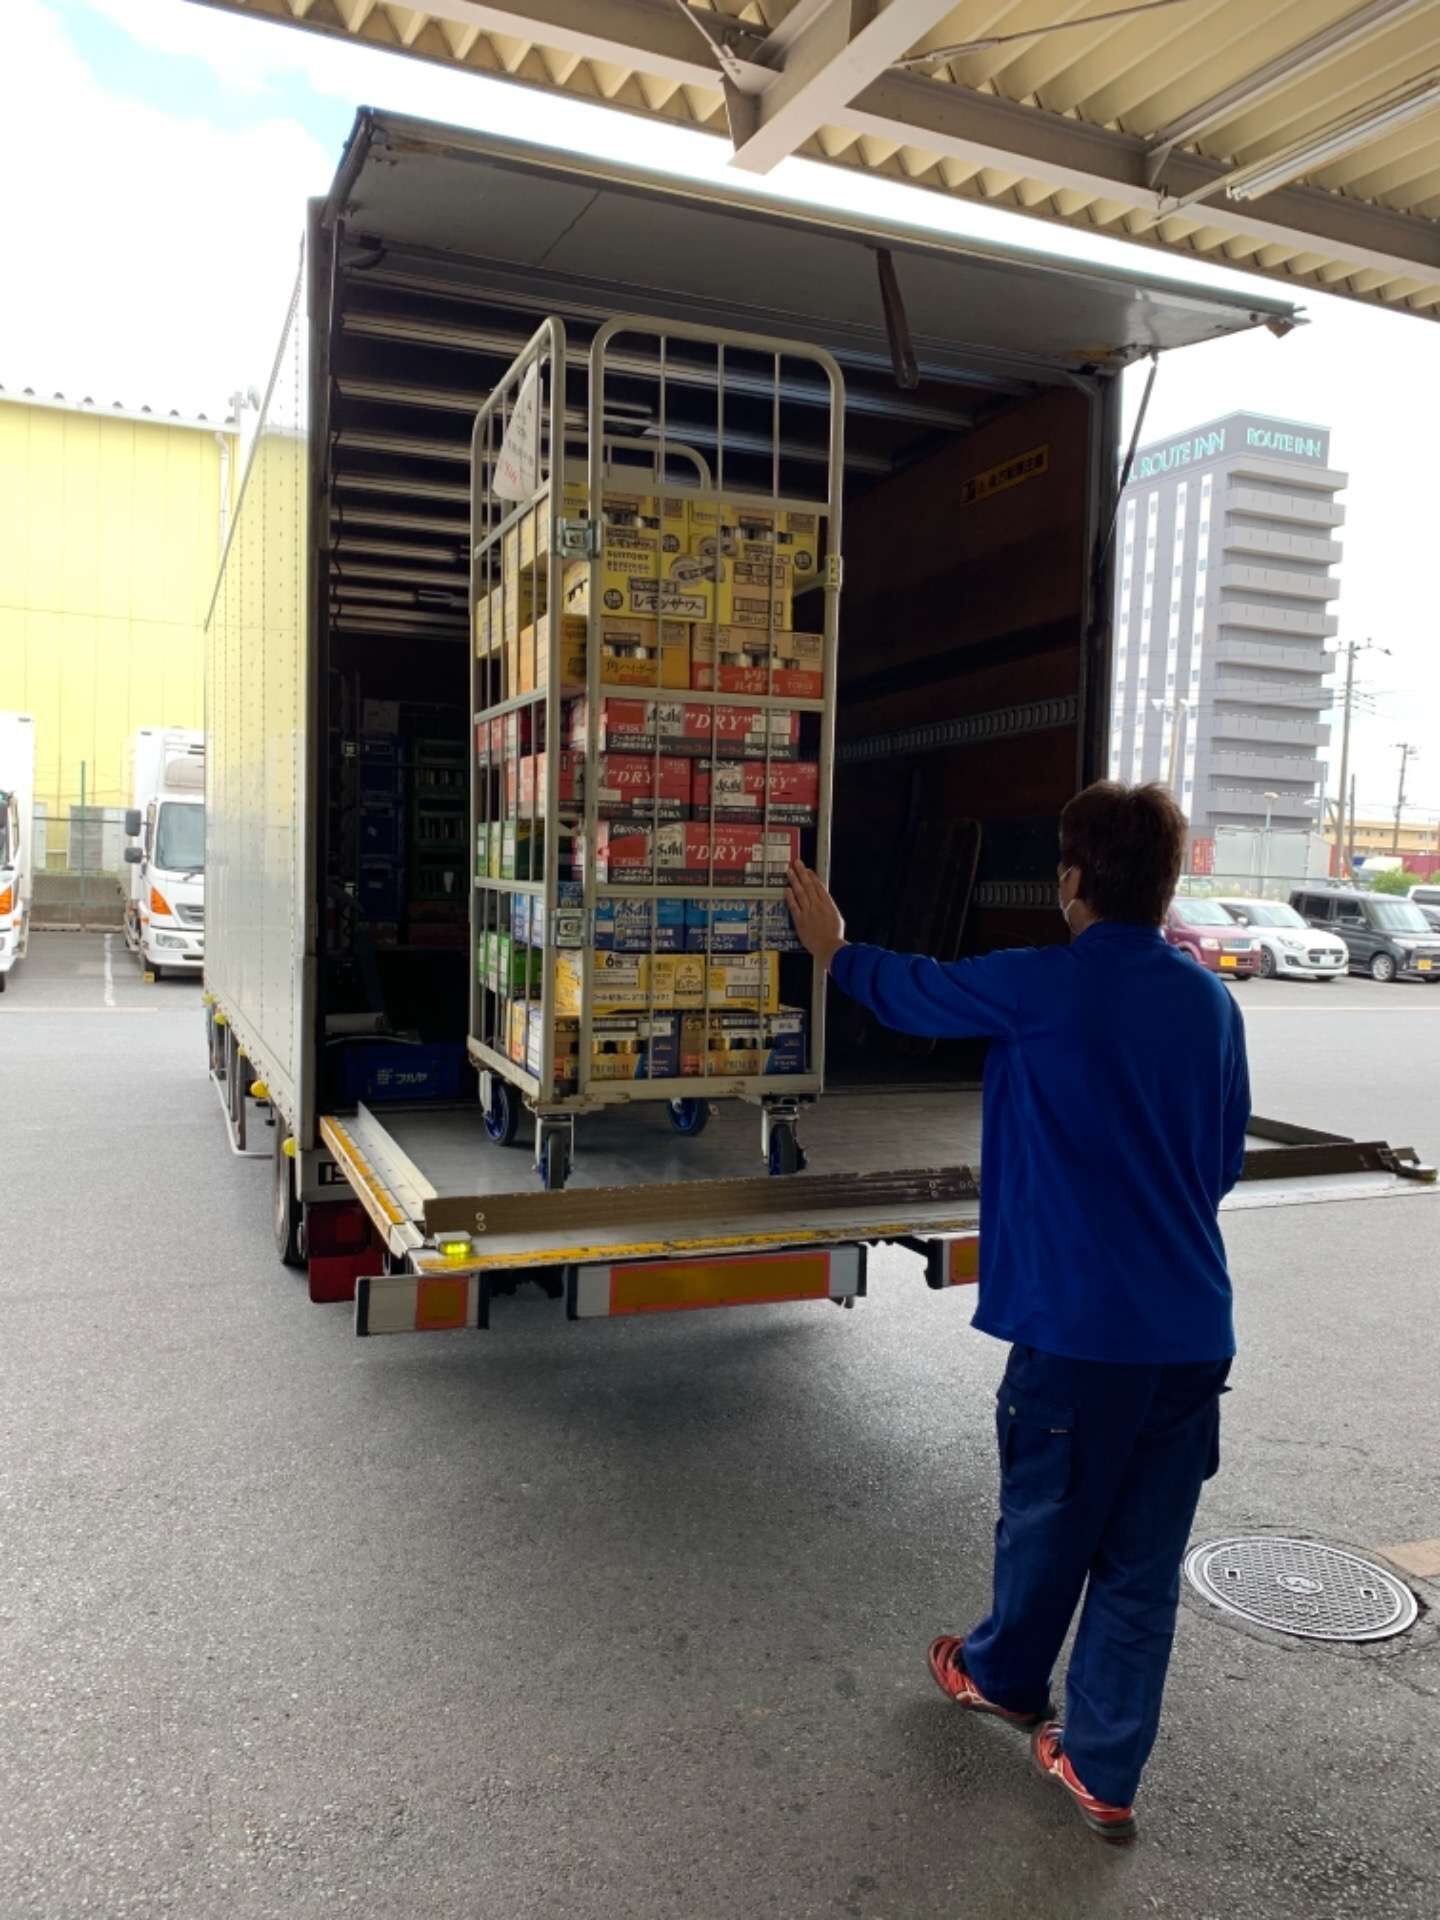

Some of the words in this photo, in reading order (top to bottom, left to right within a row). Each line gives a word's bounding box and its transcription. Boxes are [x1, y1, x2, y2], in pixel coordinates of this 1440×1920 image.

[1140, 440, 1190, 477] ROUTE
[1193, 429, 1225, 461] INN
[1245, 427, 1292, 450] ROUTE
[1295, 438, 1321, 458] INN
[633, 593, 704, 611] レモンサワー
